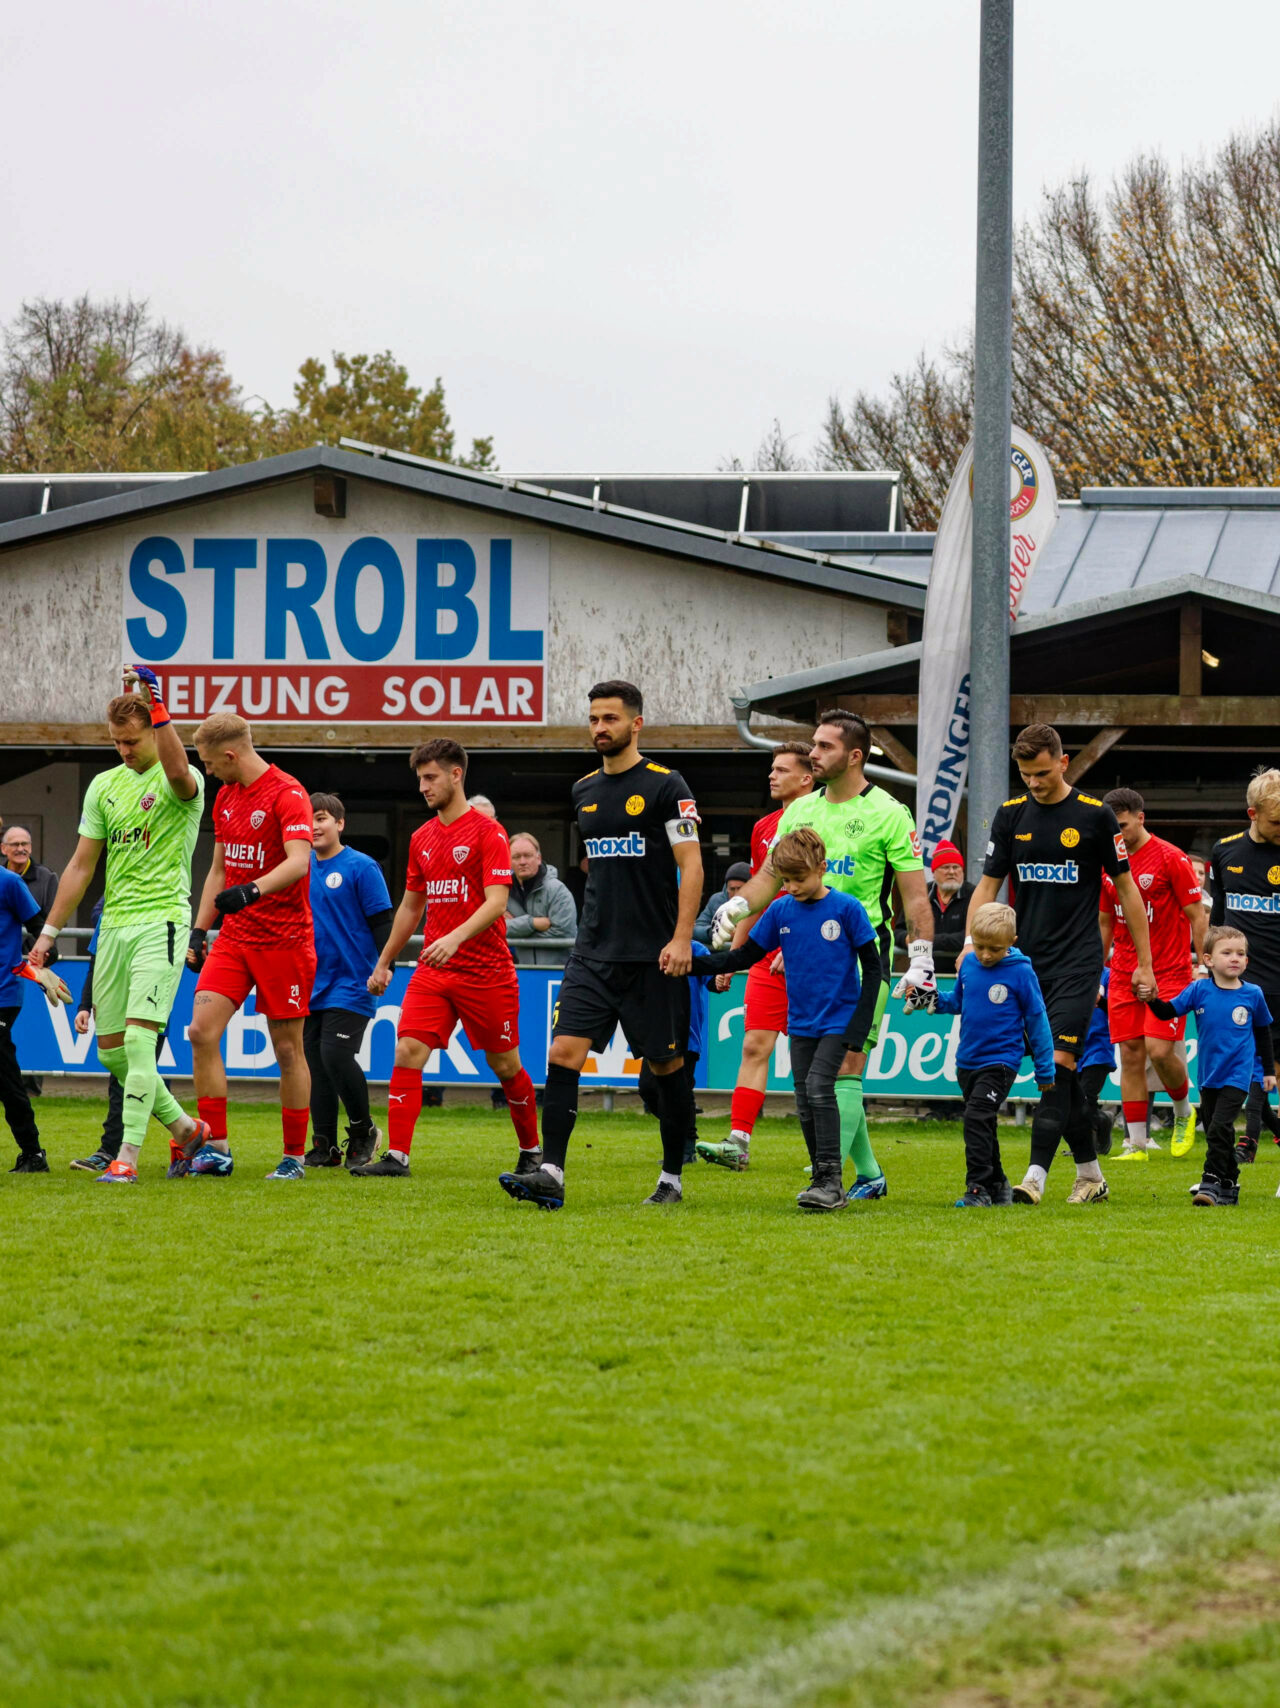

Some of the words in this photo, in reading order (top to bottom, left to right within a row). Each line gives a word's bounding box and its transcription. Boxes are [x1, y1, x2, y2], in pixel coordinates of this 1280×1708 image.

[126, 536, 544, 662] STROBL
[382, 676, 535, 716] SOLAR
[224, 842, 255, 860] AUER
[584, 832, 645, 858] maxit
[825, 855, 855, 877] xit
[1016, 860, 1079, 883] maxit
[290, 984, 300, 997] 28
